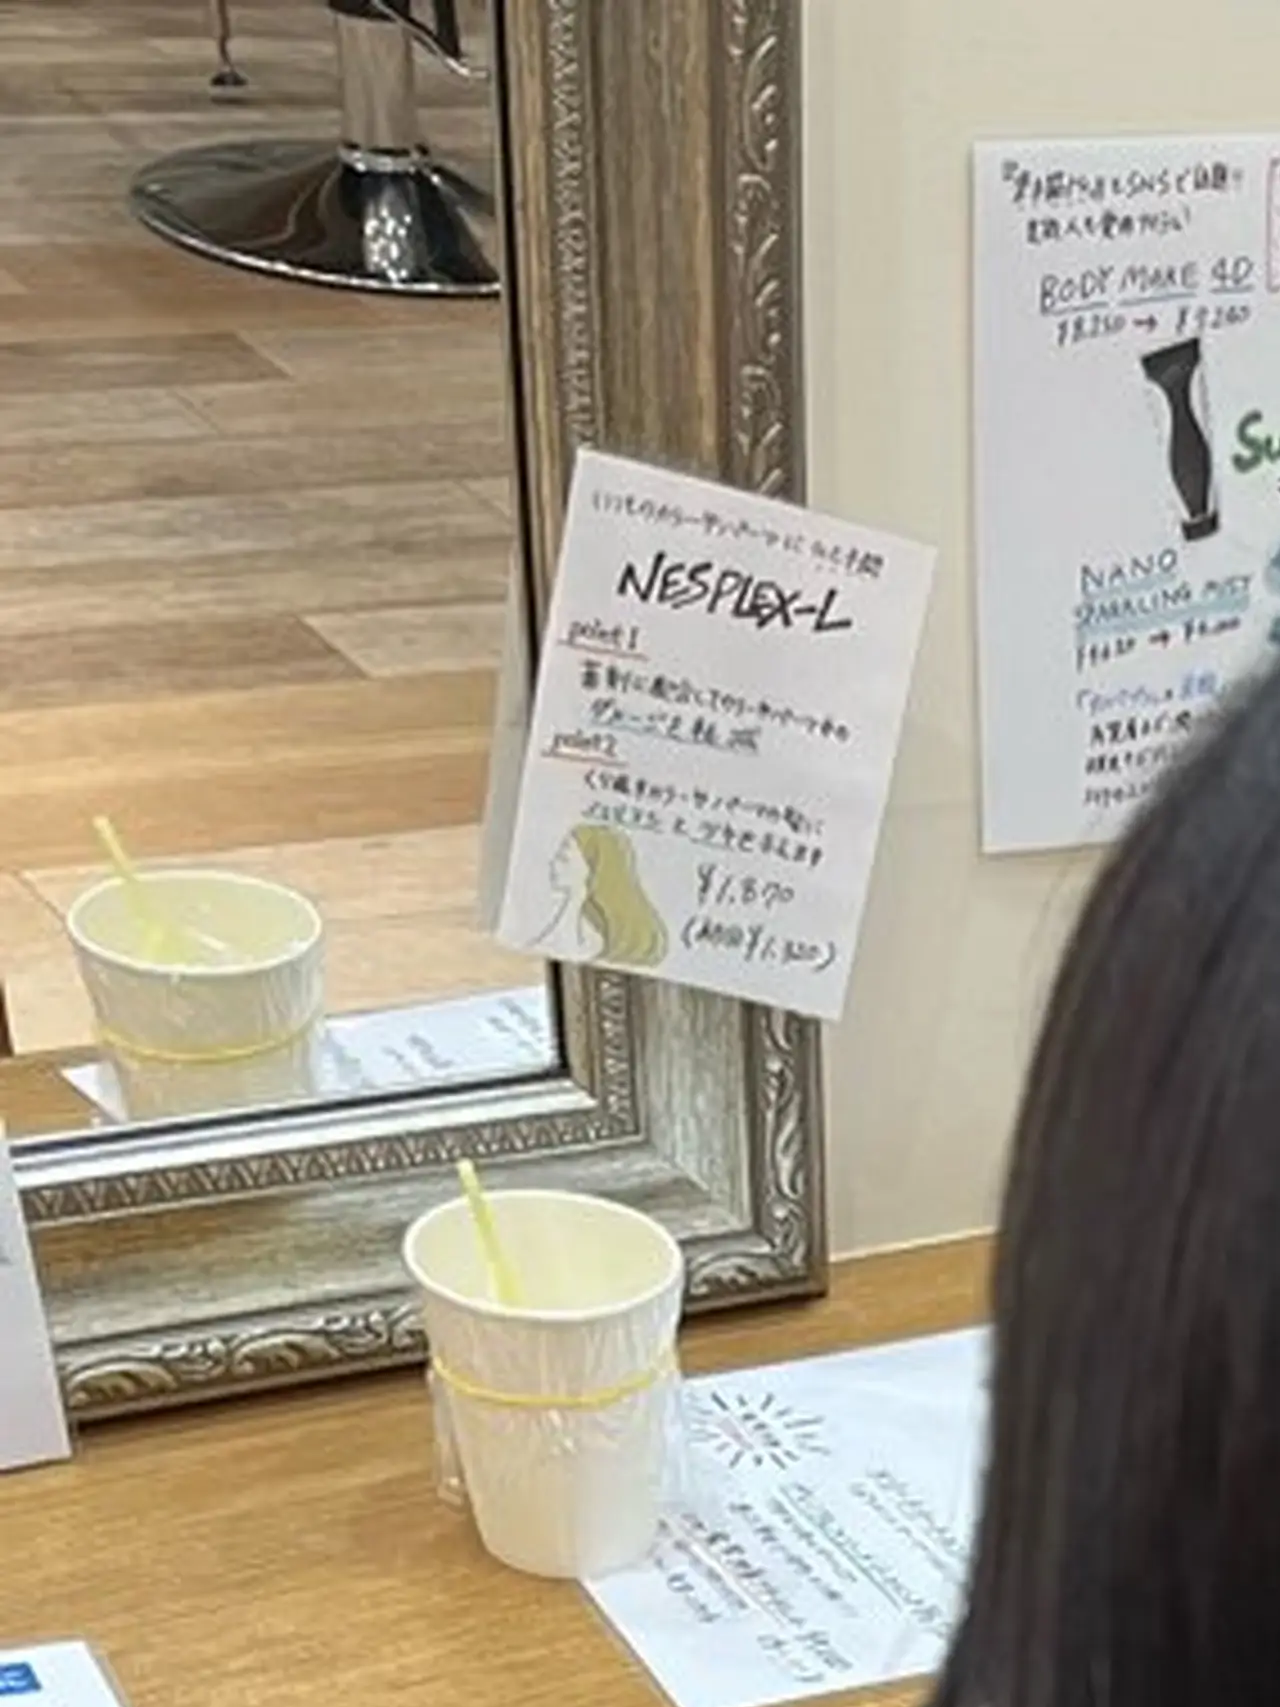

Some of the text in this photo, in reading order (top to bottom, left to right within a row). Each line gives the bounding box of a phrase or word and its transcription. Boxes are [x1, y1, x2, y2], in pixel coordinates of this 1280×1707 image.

[1040, 265, 1114, 311] BODY
[1118, 261, 1199, 294] MAKE
[616, 550, 852, 633] NESPLEX-L
[1081, 548, 1178, 599] NANO
